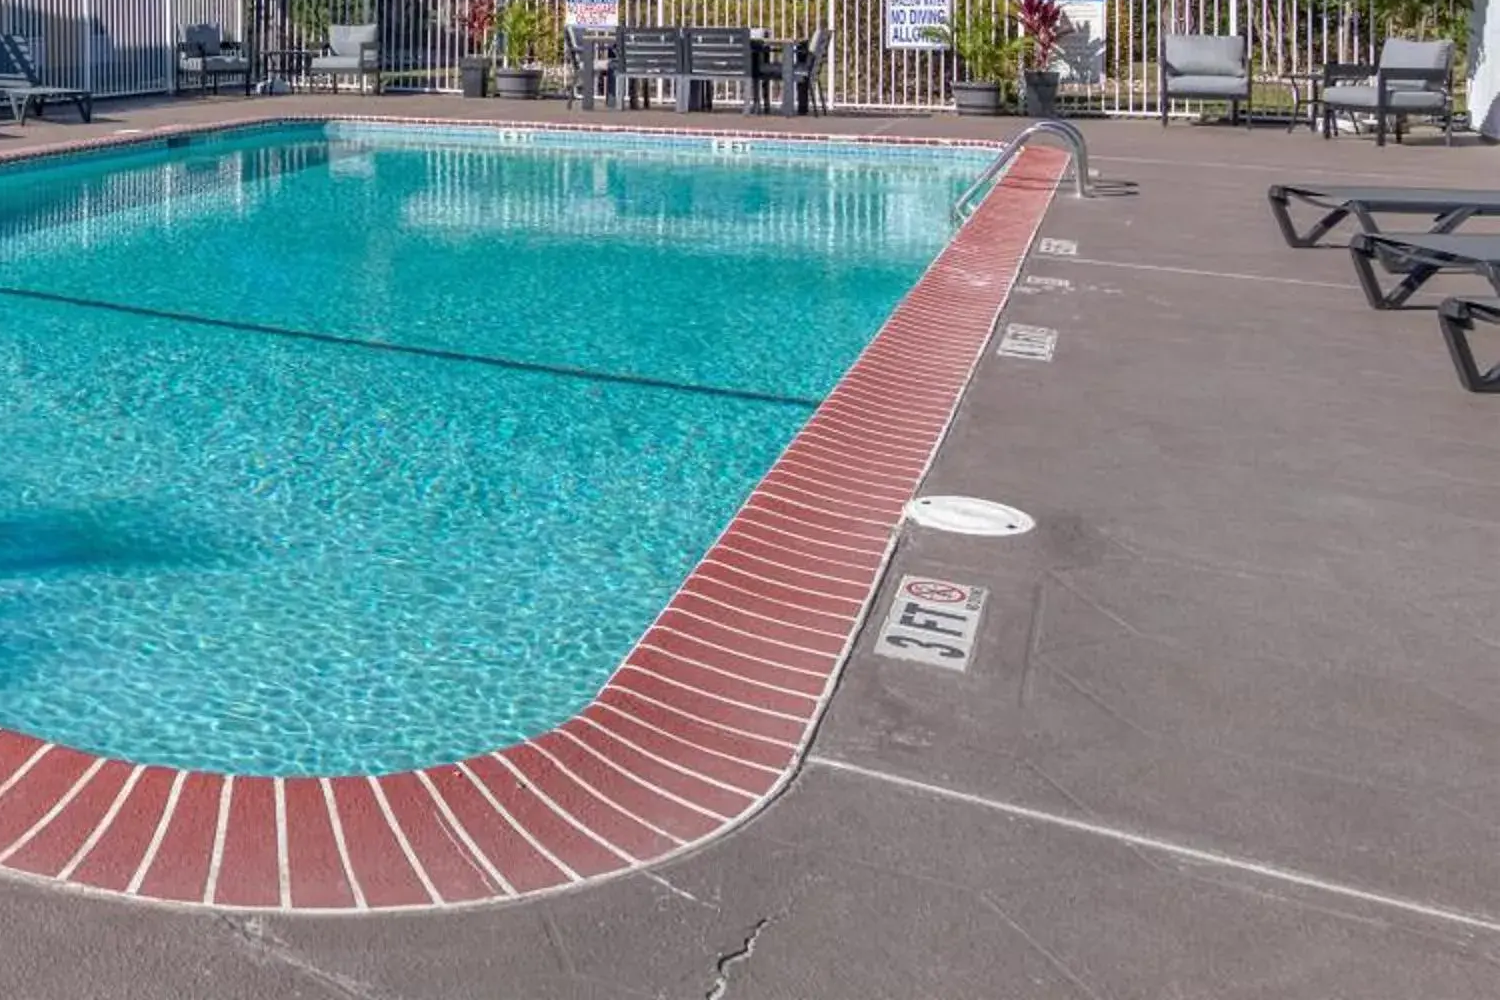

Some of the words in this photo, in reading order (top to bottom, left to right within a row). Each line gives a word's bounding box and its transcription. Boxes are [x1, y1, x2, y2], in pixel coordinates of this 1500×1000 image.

[891, 9, 906, 24] NO
[910, 9, 945, 24] DIVING
[900, 602, 967, 638] FT
[885, 635, 965, 659] 3
